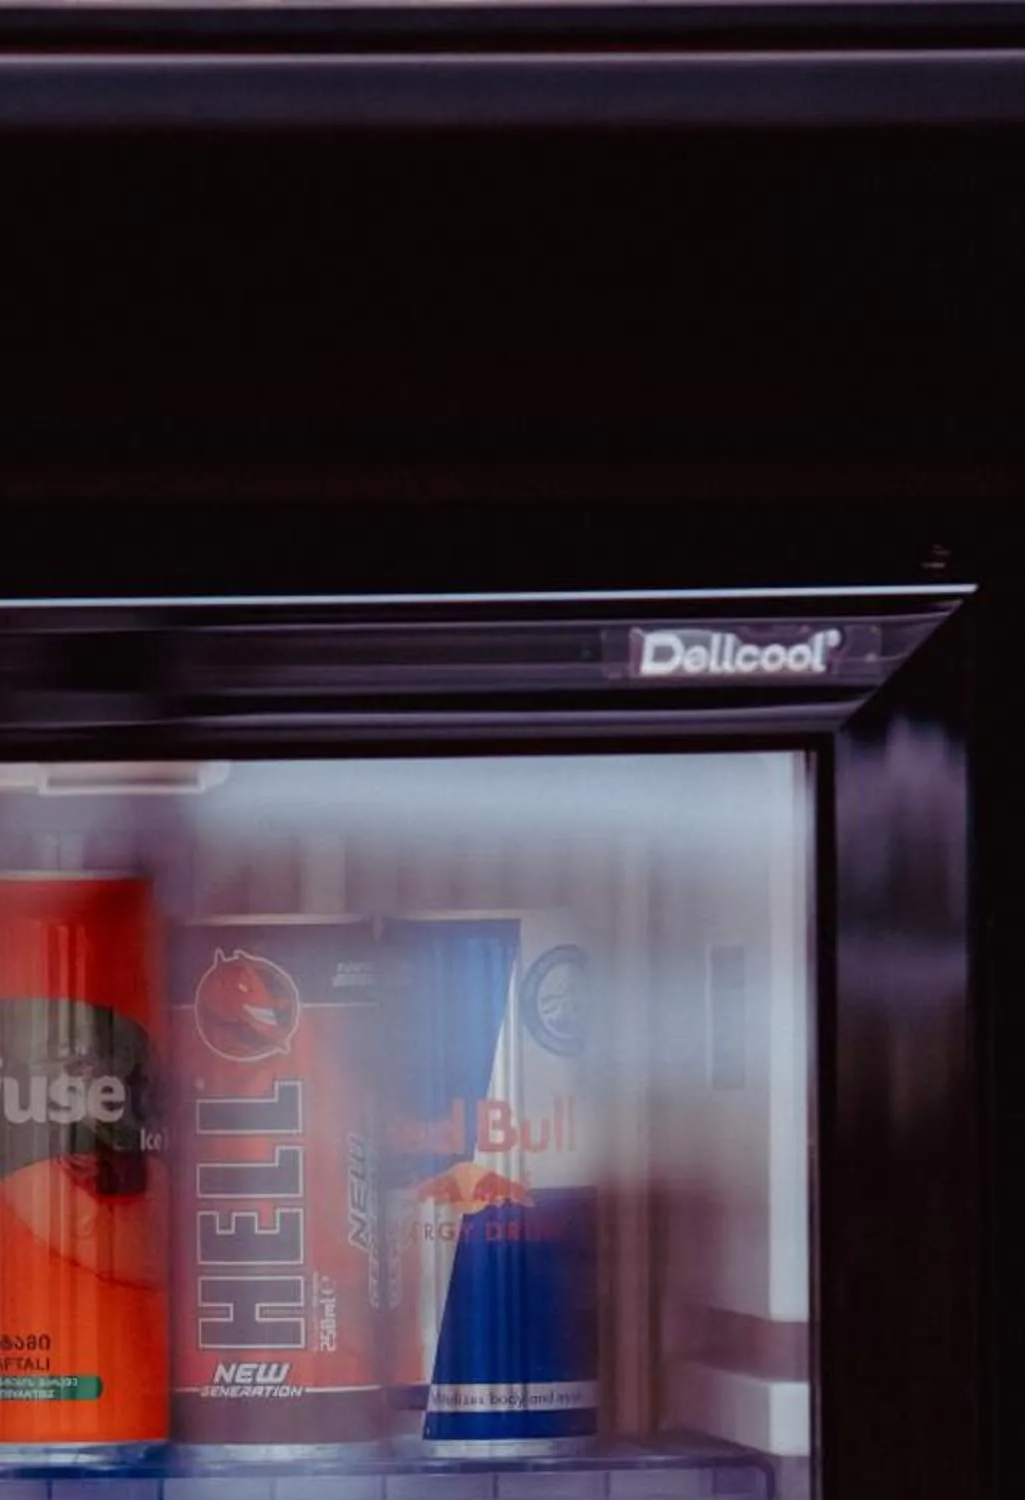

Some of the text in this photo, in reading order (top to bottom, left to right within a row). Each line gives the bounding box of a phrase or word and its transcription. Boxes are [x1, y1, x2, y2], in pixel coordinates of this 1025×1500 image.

[477, 1094, 576, 1153] Bull
[197, 1080, 305, 1350] HELL
[200, 1384, 304, 1398] GENERATION
[213, 1362, 290, 1386] NEW
